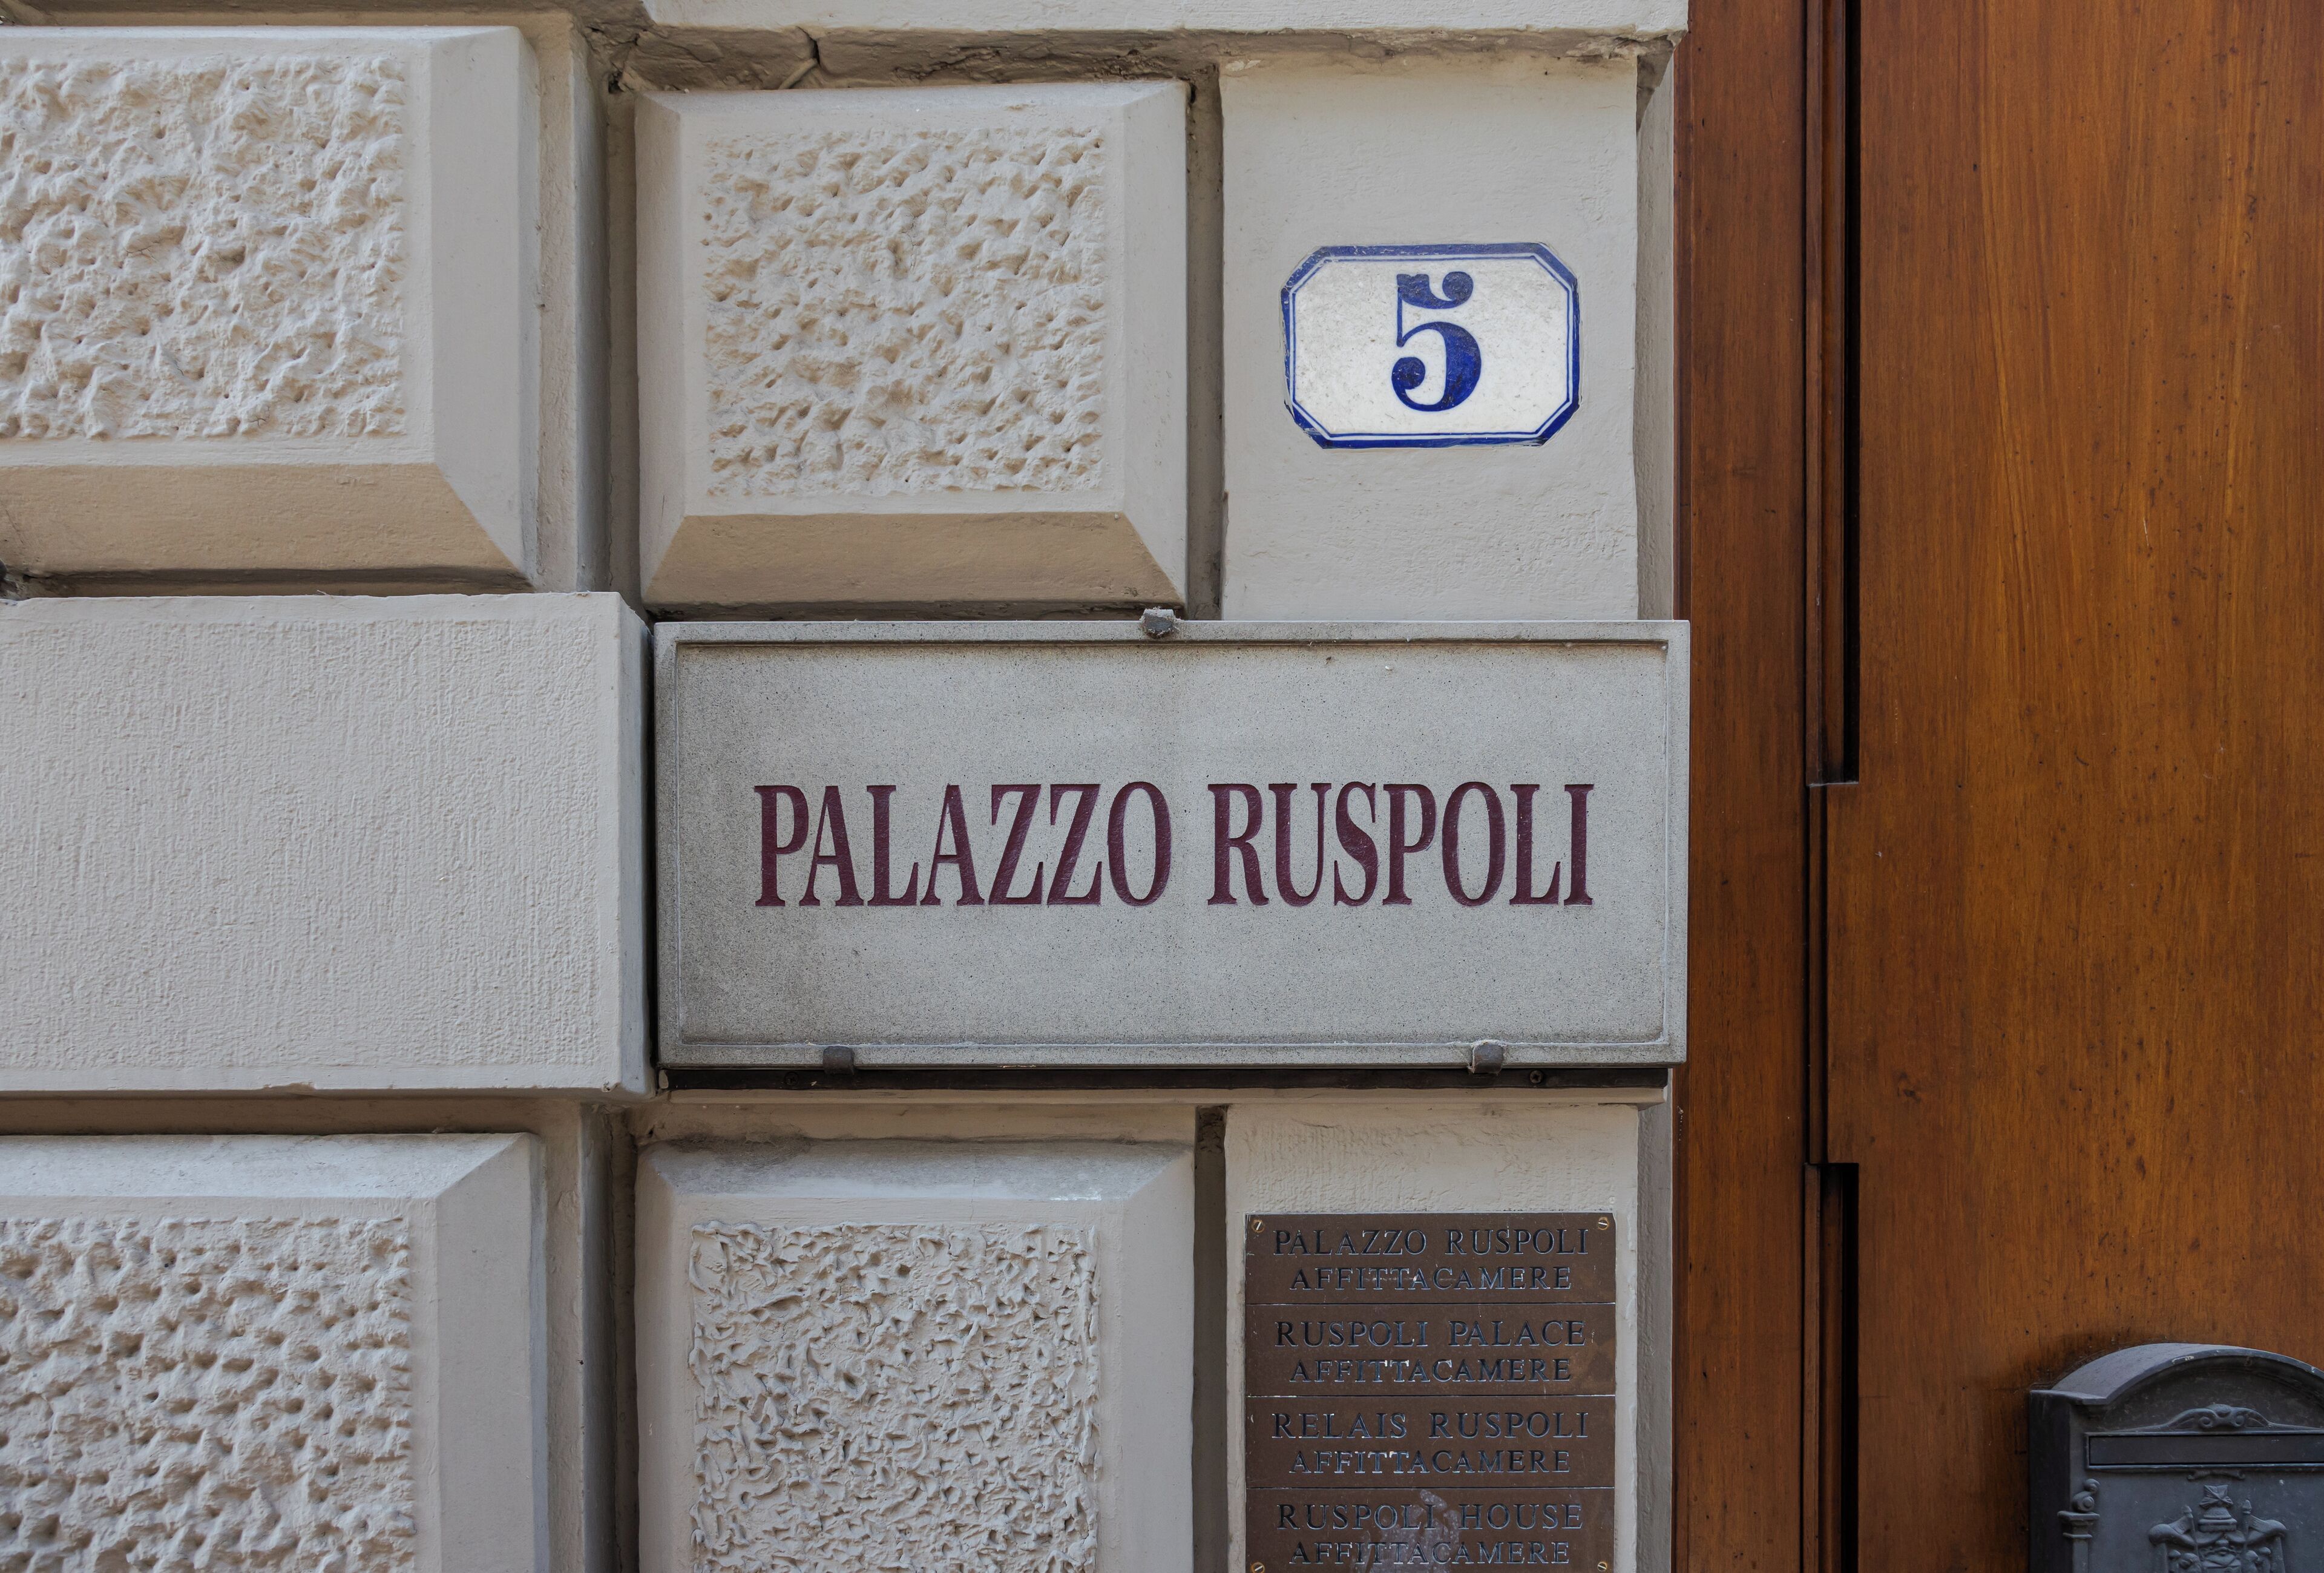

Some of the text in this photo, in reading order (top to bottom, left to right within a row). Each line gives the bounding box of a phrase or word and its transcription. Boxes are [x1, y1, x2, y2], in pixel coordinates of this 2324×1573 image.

[1392, 272, 1481, 412] 5
[754, 781, 1594, 906] PALAZZO RUSPOLI
[1273, 1229, 1588, 1255] PALAZZO RUSPOLI
[1290, 1267, 1571, 1290] AFFITTACAMERE
[1275, 1321, 1586, 1347] RUSPOLI PALACE
[1290, 1359, 1571, 1382] AFFITTACAMERE
[1272, 1411, 1588, 1439] RELAIS RUSPOLI
[1289, 1450, 1570, 1474] AFFITTACAMERE
[1277, 1503, 1583, 1530] RUSPOLI HOUSE
[1289, 1541, 1569, 1565] AFFITTACAMERE
